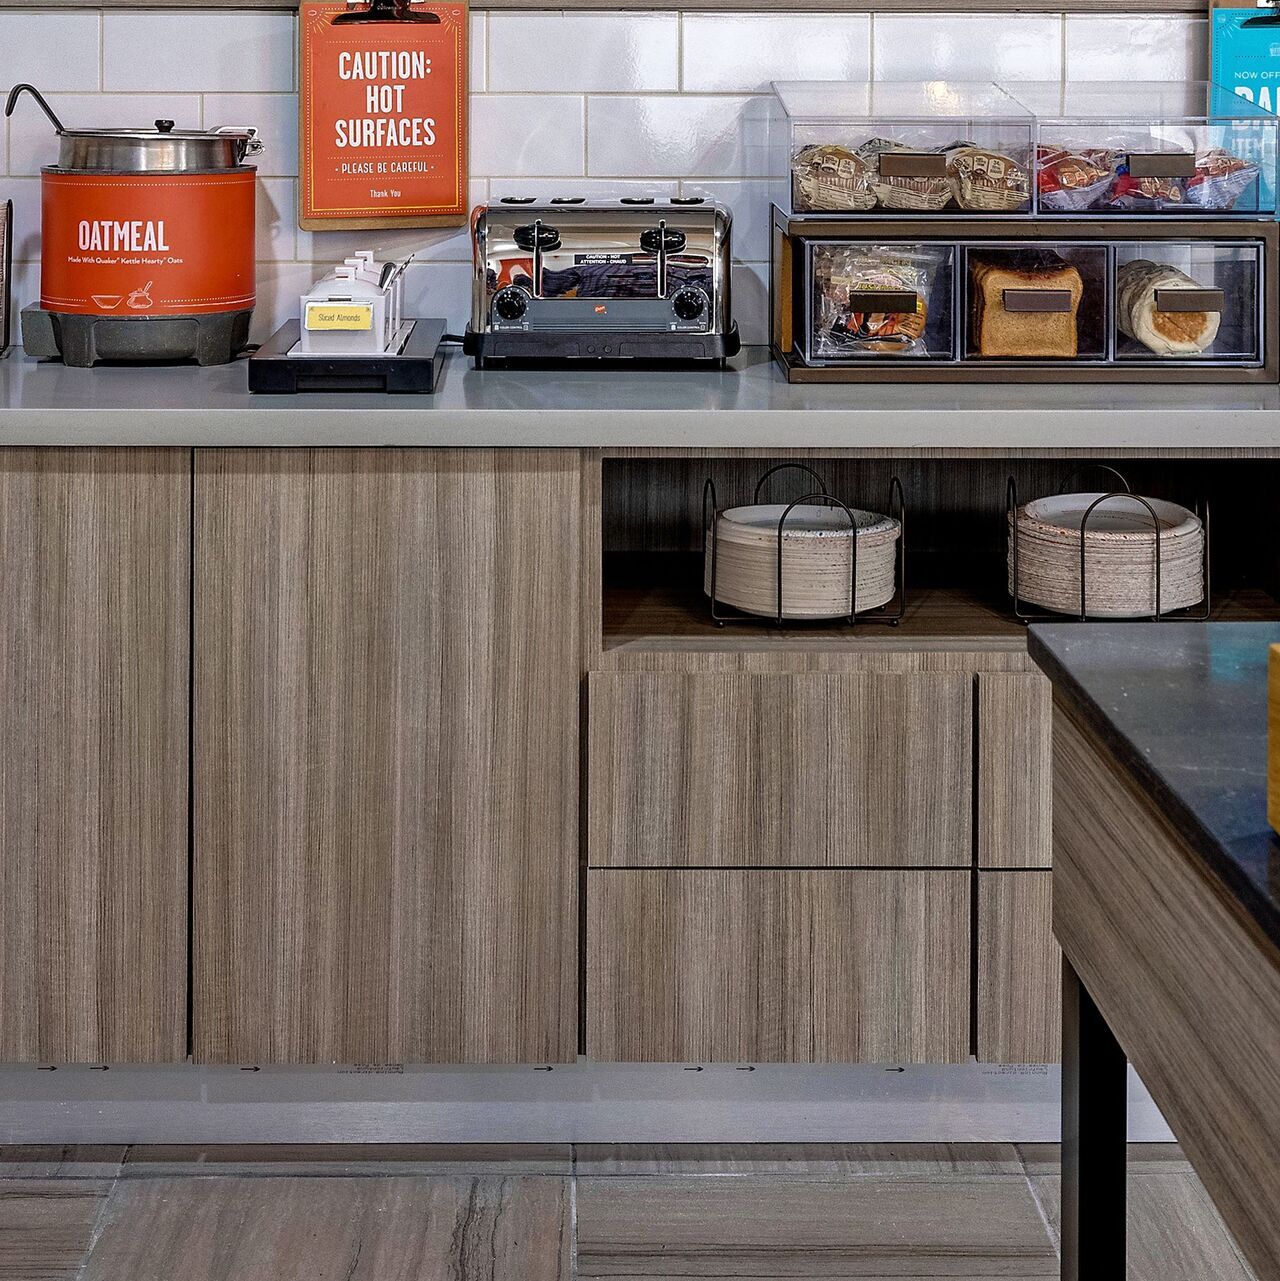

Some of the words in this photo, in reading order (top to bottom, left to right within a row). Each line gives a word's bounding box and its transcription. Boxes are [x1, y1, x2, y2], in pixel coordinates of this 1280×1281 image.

[338, 51, 432, 80] CAUTION:
[1234, 71, 1258, 79] NOW
[366, 85, 406, 114] HOT
[335, 117, 436, 148] SURFACES
[341, 163, 374, 174] PLEASE
[377, 162, 389, 173] BE
[391, 161, 428, 173] CAREFUL
[370, 189, 388, 198] Thank
[390, 189, 401, 198] You
[78, 220, 170, 252] OATMEAL
[167, 256, 183, 264] Oats
[337, 313, 361, 322] Almonds
